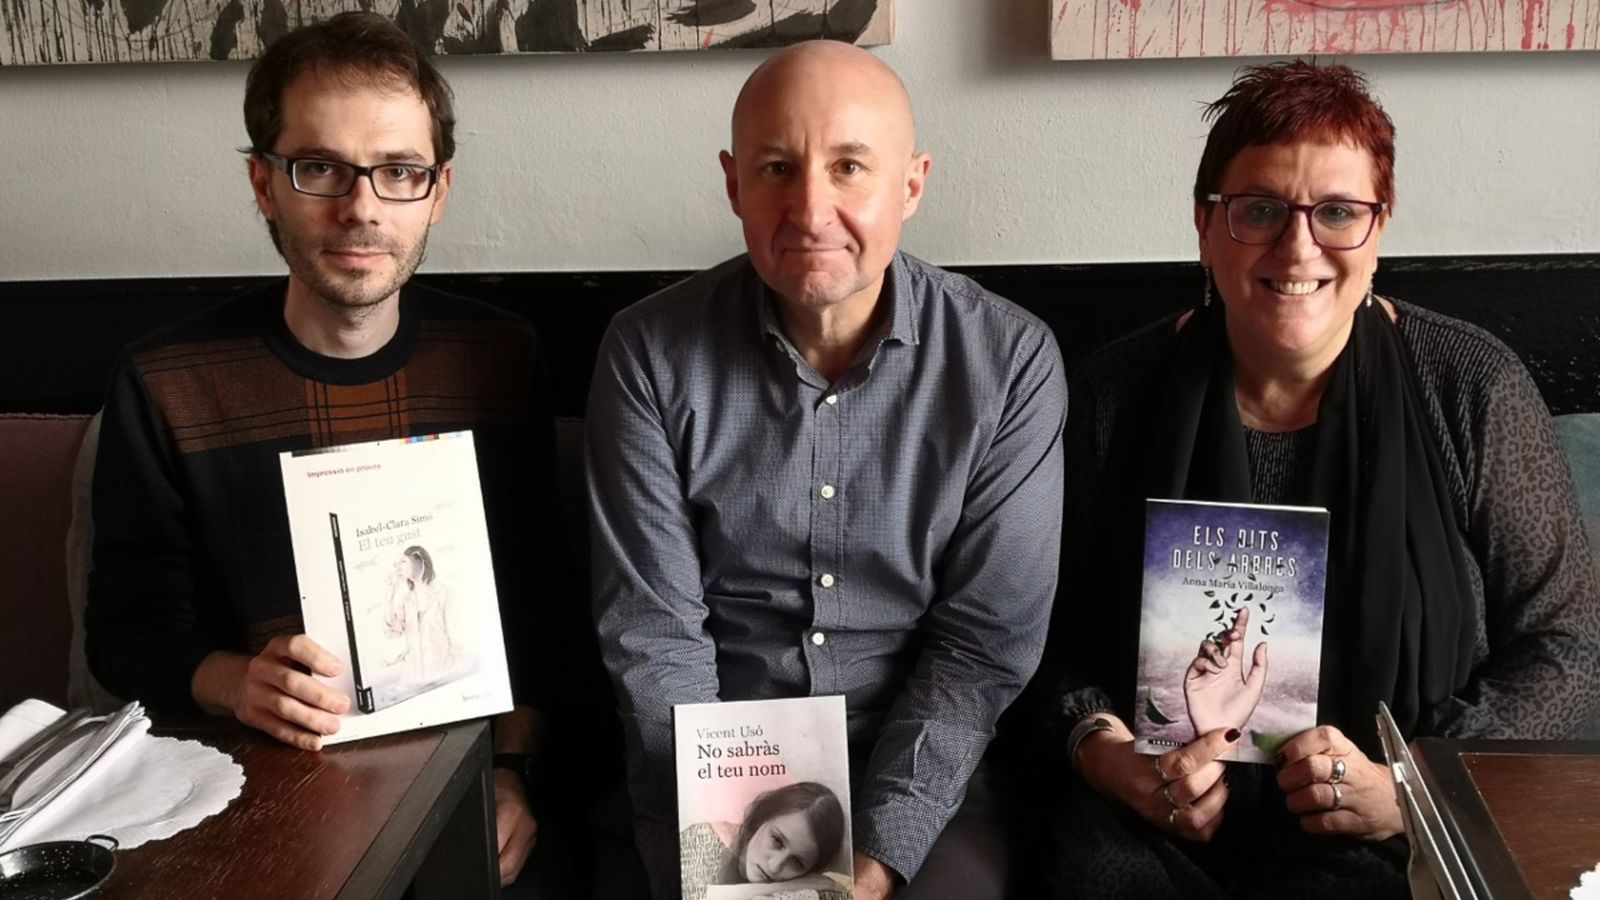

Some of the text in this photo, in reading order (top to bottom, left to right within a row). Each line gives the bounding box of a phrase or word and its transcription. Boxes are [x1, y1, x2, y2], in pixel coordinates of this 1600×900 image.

[355, 519, 410, 538] Isabel-Clara
[358, 529, 421, 552] El teu gust
[1193, 526, 1279, 551] ELS DITS
[1173, 549, 1297, 577] DELS ARBRES
[1182, 577, 1207, 587] Anna
[1238, 581, 1284, 594] Villalonga
[696, 725, 764, 739] Vicent Usó
[697, 740, 780, 759] No sabràs
[697, 763, 787, 779] el teu nom
